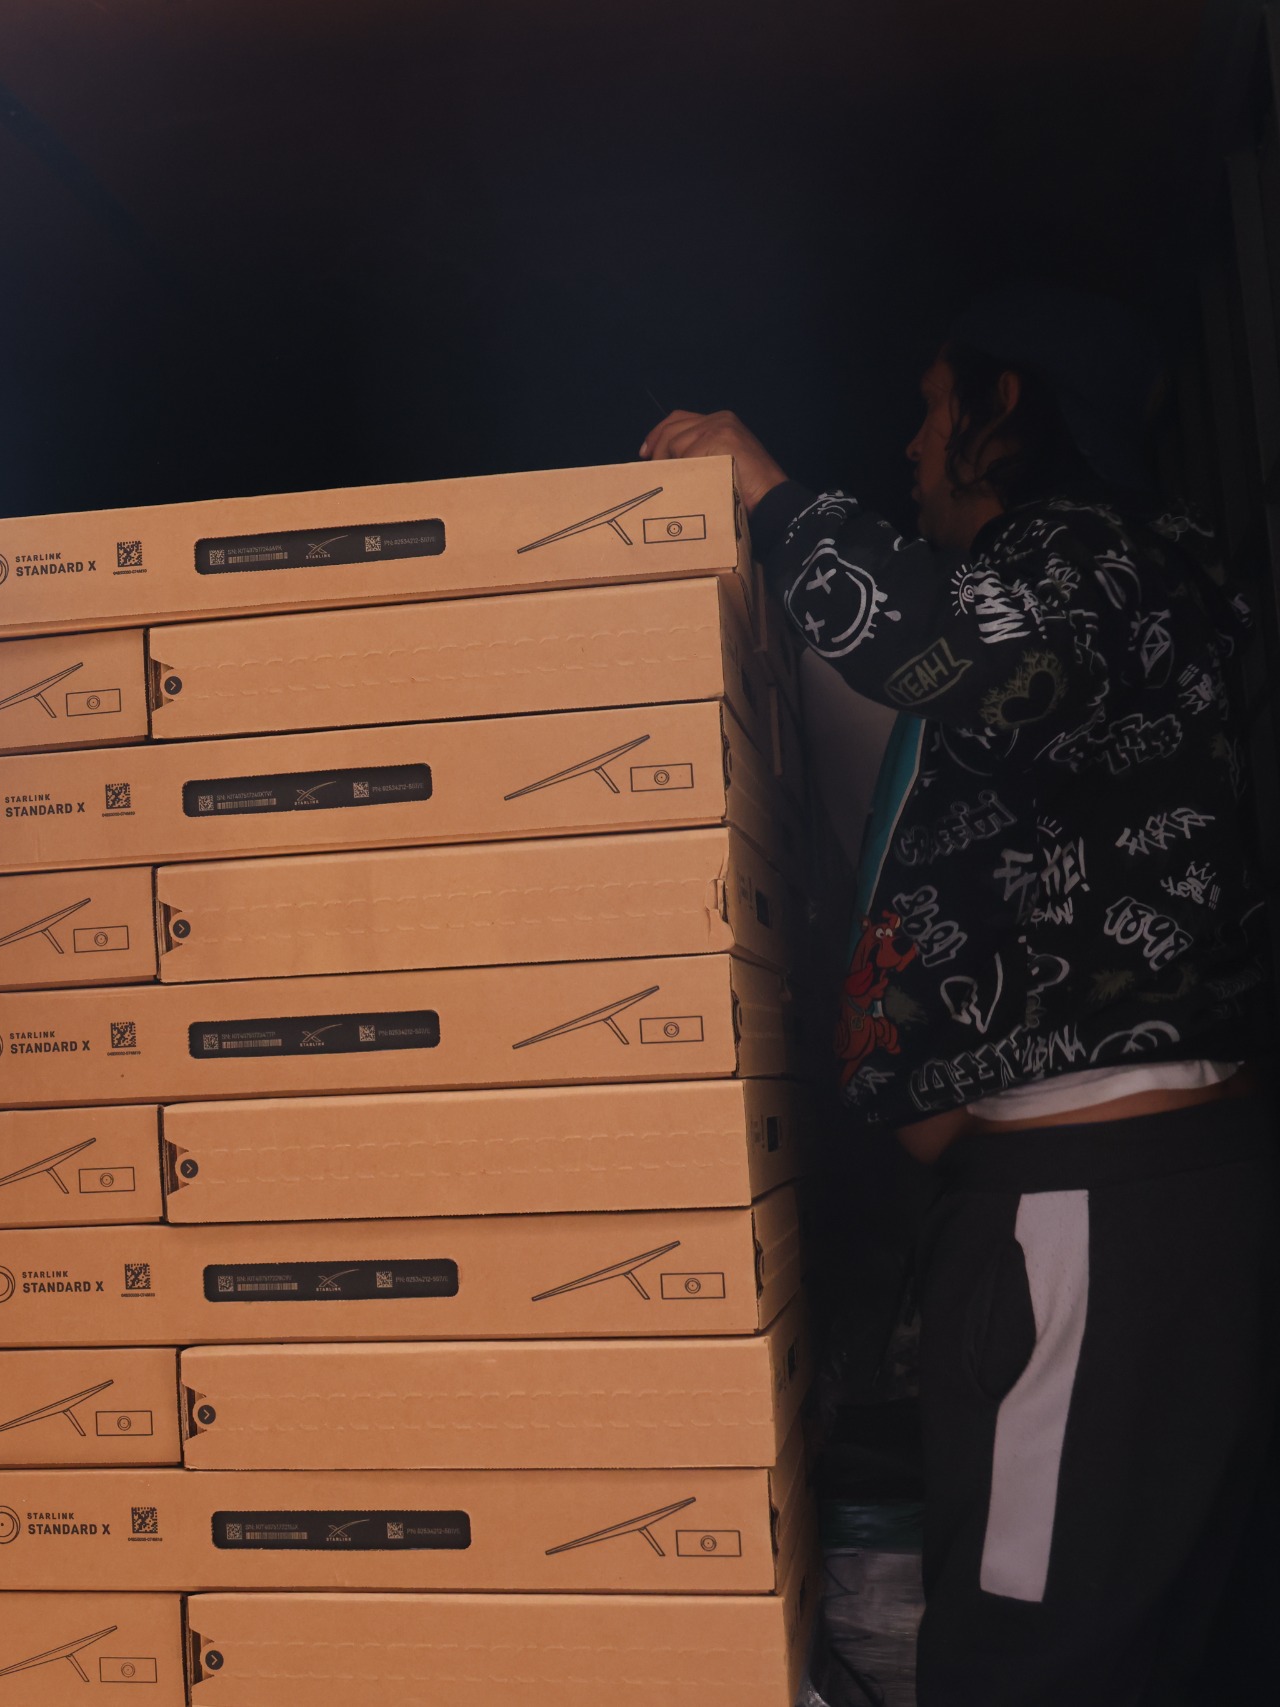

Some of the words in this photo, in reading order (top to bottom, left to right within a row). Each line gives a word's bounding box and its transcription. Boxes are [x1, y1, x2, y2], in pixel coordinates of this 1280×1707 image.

[15, 552, 62, 563] STARLINK
[15, 561, 84, 577] STANDARD
[88, 561, 97, 572] X
[890, 651, 949, 702] YEAH
[5, 793, 51, 803] STARLINK
[5, 802, 73, 818] STANDARD
[76, 801, 86, 813] X
[10, 1030, 56, 1040] STARLINK
[10, 1041, 78, 1055] STANDARD
[82, 1039, 91, 1052] X
[22, 1270, 69, 1279] STARLINK
[23, 1281, 92, 1294] STANDARD
[96, 1280, 105, 1292] X
[27, 1512, 75, 1520] STARLINK
[28, 1523, 98, 1535] STANDARD
[102, 1523, 111, 1535] X
